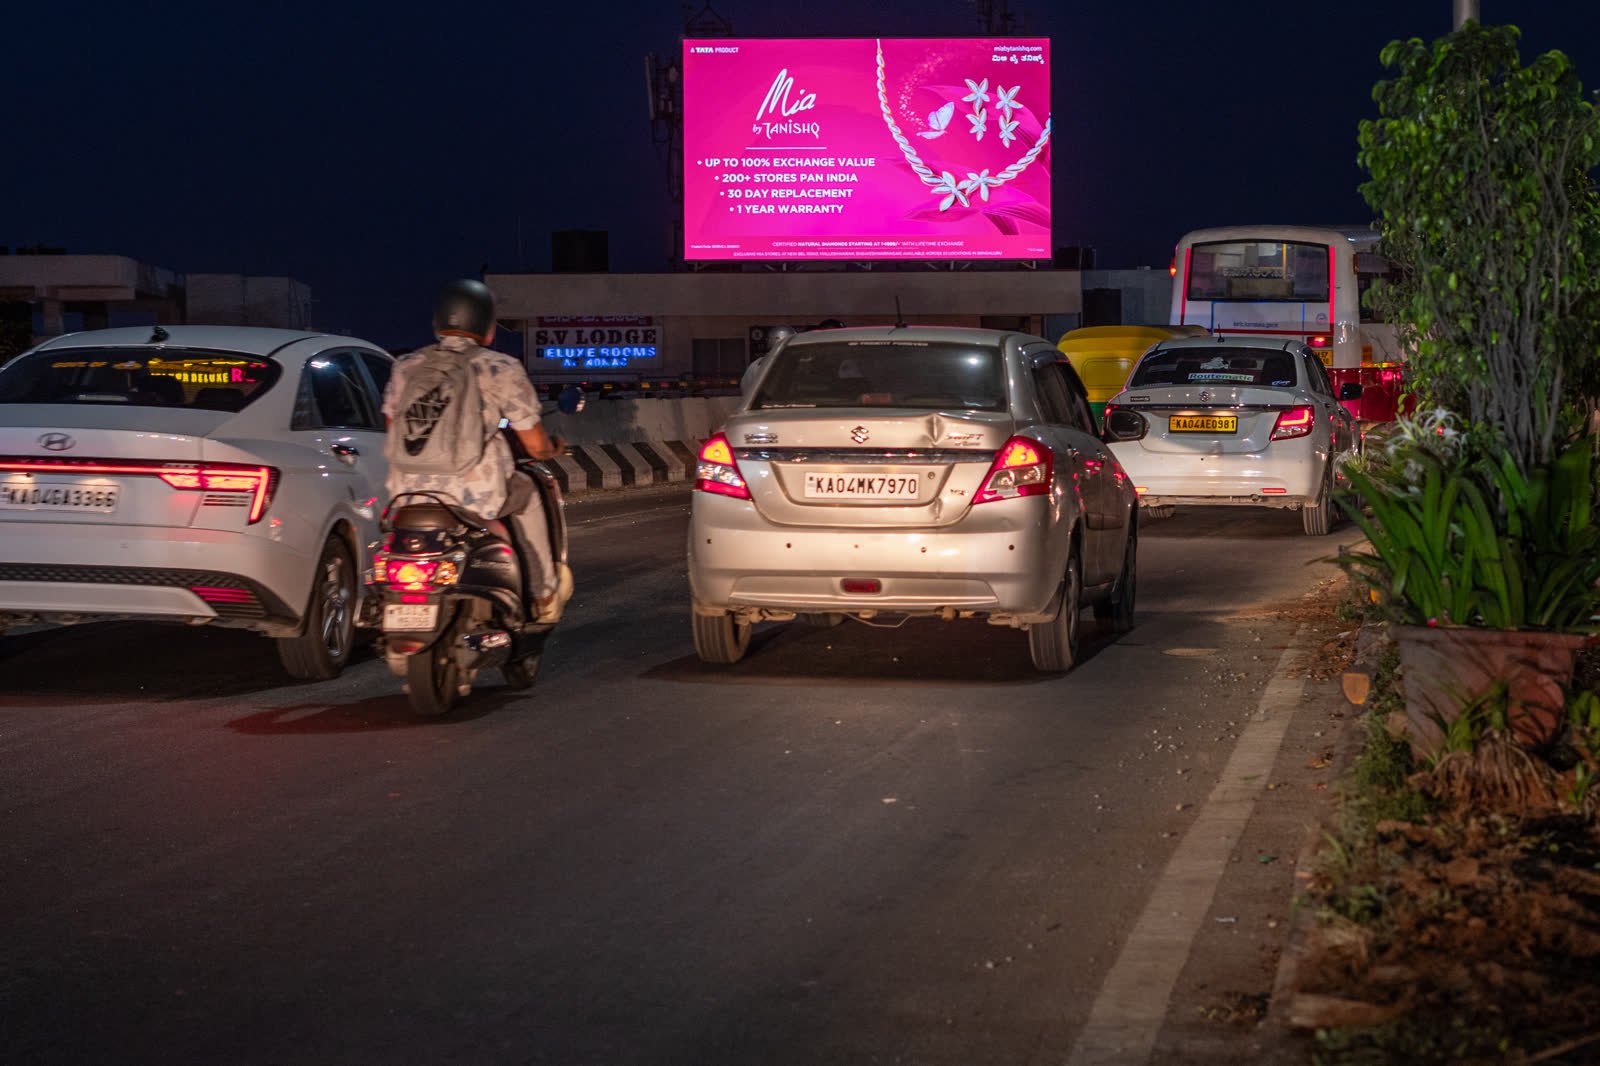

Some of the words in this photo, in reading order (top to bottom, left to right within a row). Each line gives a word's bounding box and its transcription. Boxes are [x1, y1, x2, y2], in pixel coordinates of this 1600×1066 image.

[756, 68, 816, 121] Mia
[753, 124, 762, 134] by
[705, 158, 720, 167] UP
[723, 158, 738, 167] TO
[741, 158, 770, 167] 100%
[773, 158, 835, 167] EXCHANGE
[838, 158, 875, 166] VALUE
[722, 174, 750, 182] 200+
[754, 173, 797, 182] STORES
[800, 173, 823, 182] PAN
[826, 173, 858, 182] INDIA
[728, 189, 742, 198] 30
[745, 189, 768, 198] DAY
[771, 189, 853, 198] REPLACEMENT
[737, 205, 741, 213] 1
[745, 205, 775, 213] YEAR
[778, 204, 844, 213] WARRANTY
[536, 329, 568, 345] S.V
[576, 329, 657, 344] LODGE
[191, 373, 229, 383] DELUXE
[1190, 373, 1252, 381] Routematic
[1176, 419, 1235, 429] KA04AE0981
[816, 477, 917, 494] KA04MK7970
